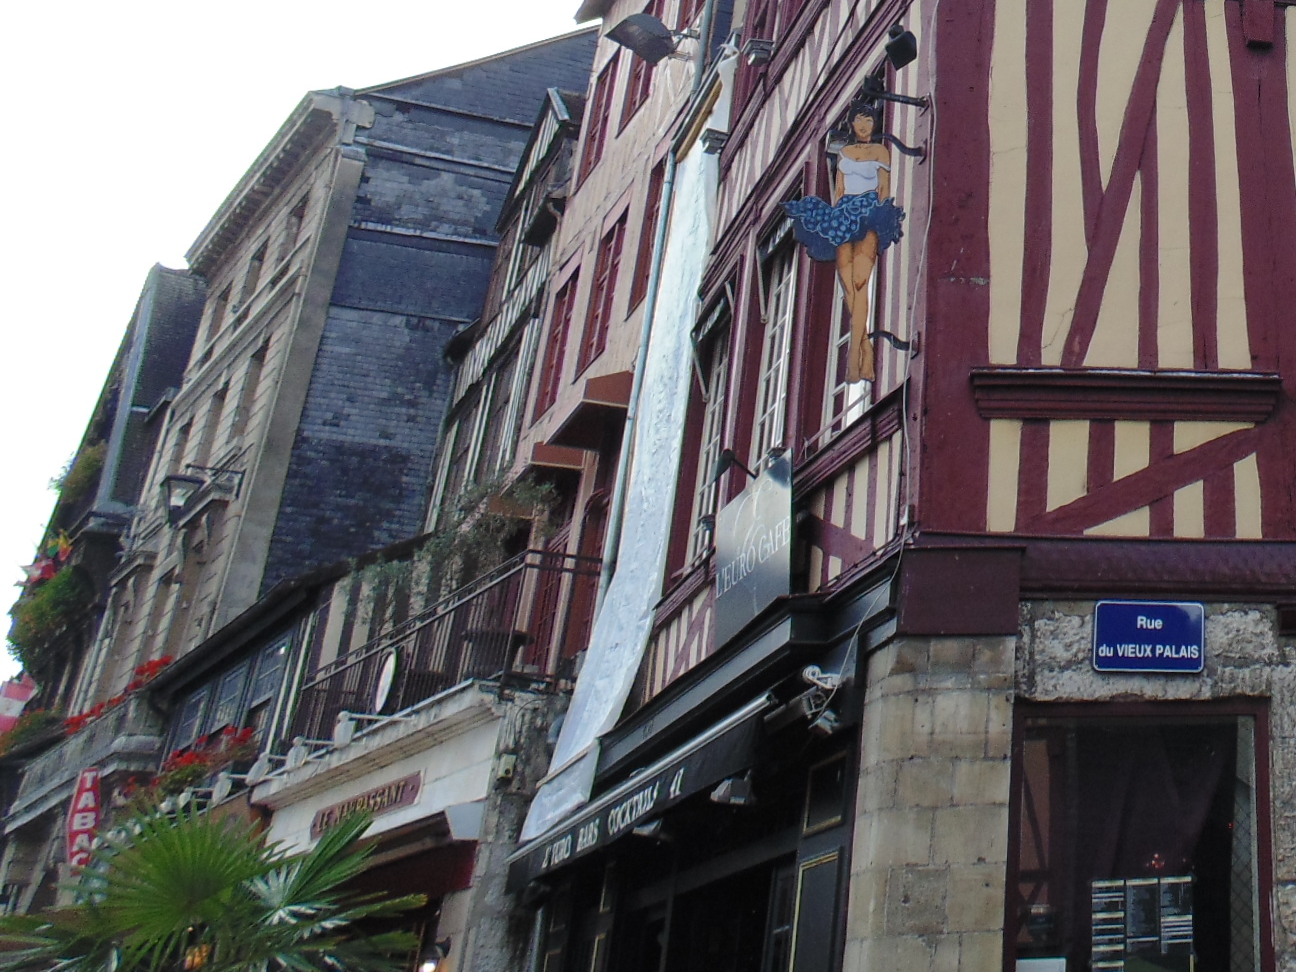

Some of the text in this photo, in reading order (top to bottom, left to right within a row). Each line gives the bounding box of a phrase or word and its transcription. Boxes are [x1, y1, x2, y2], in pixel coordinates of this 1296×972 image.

[715, 515, 790, 599] L'EURO CAFE
[1136, 615, 1163, 630] Rue
[1098, 643, 1200, 659] du VIEUX PALAIS
[607, 780, 660, 836] COCKTAILS
